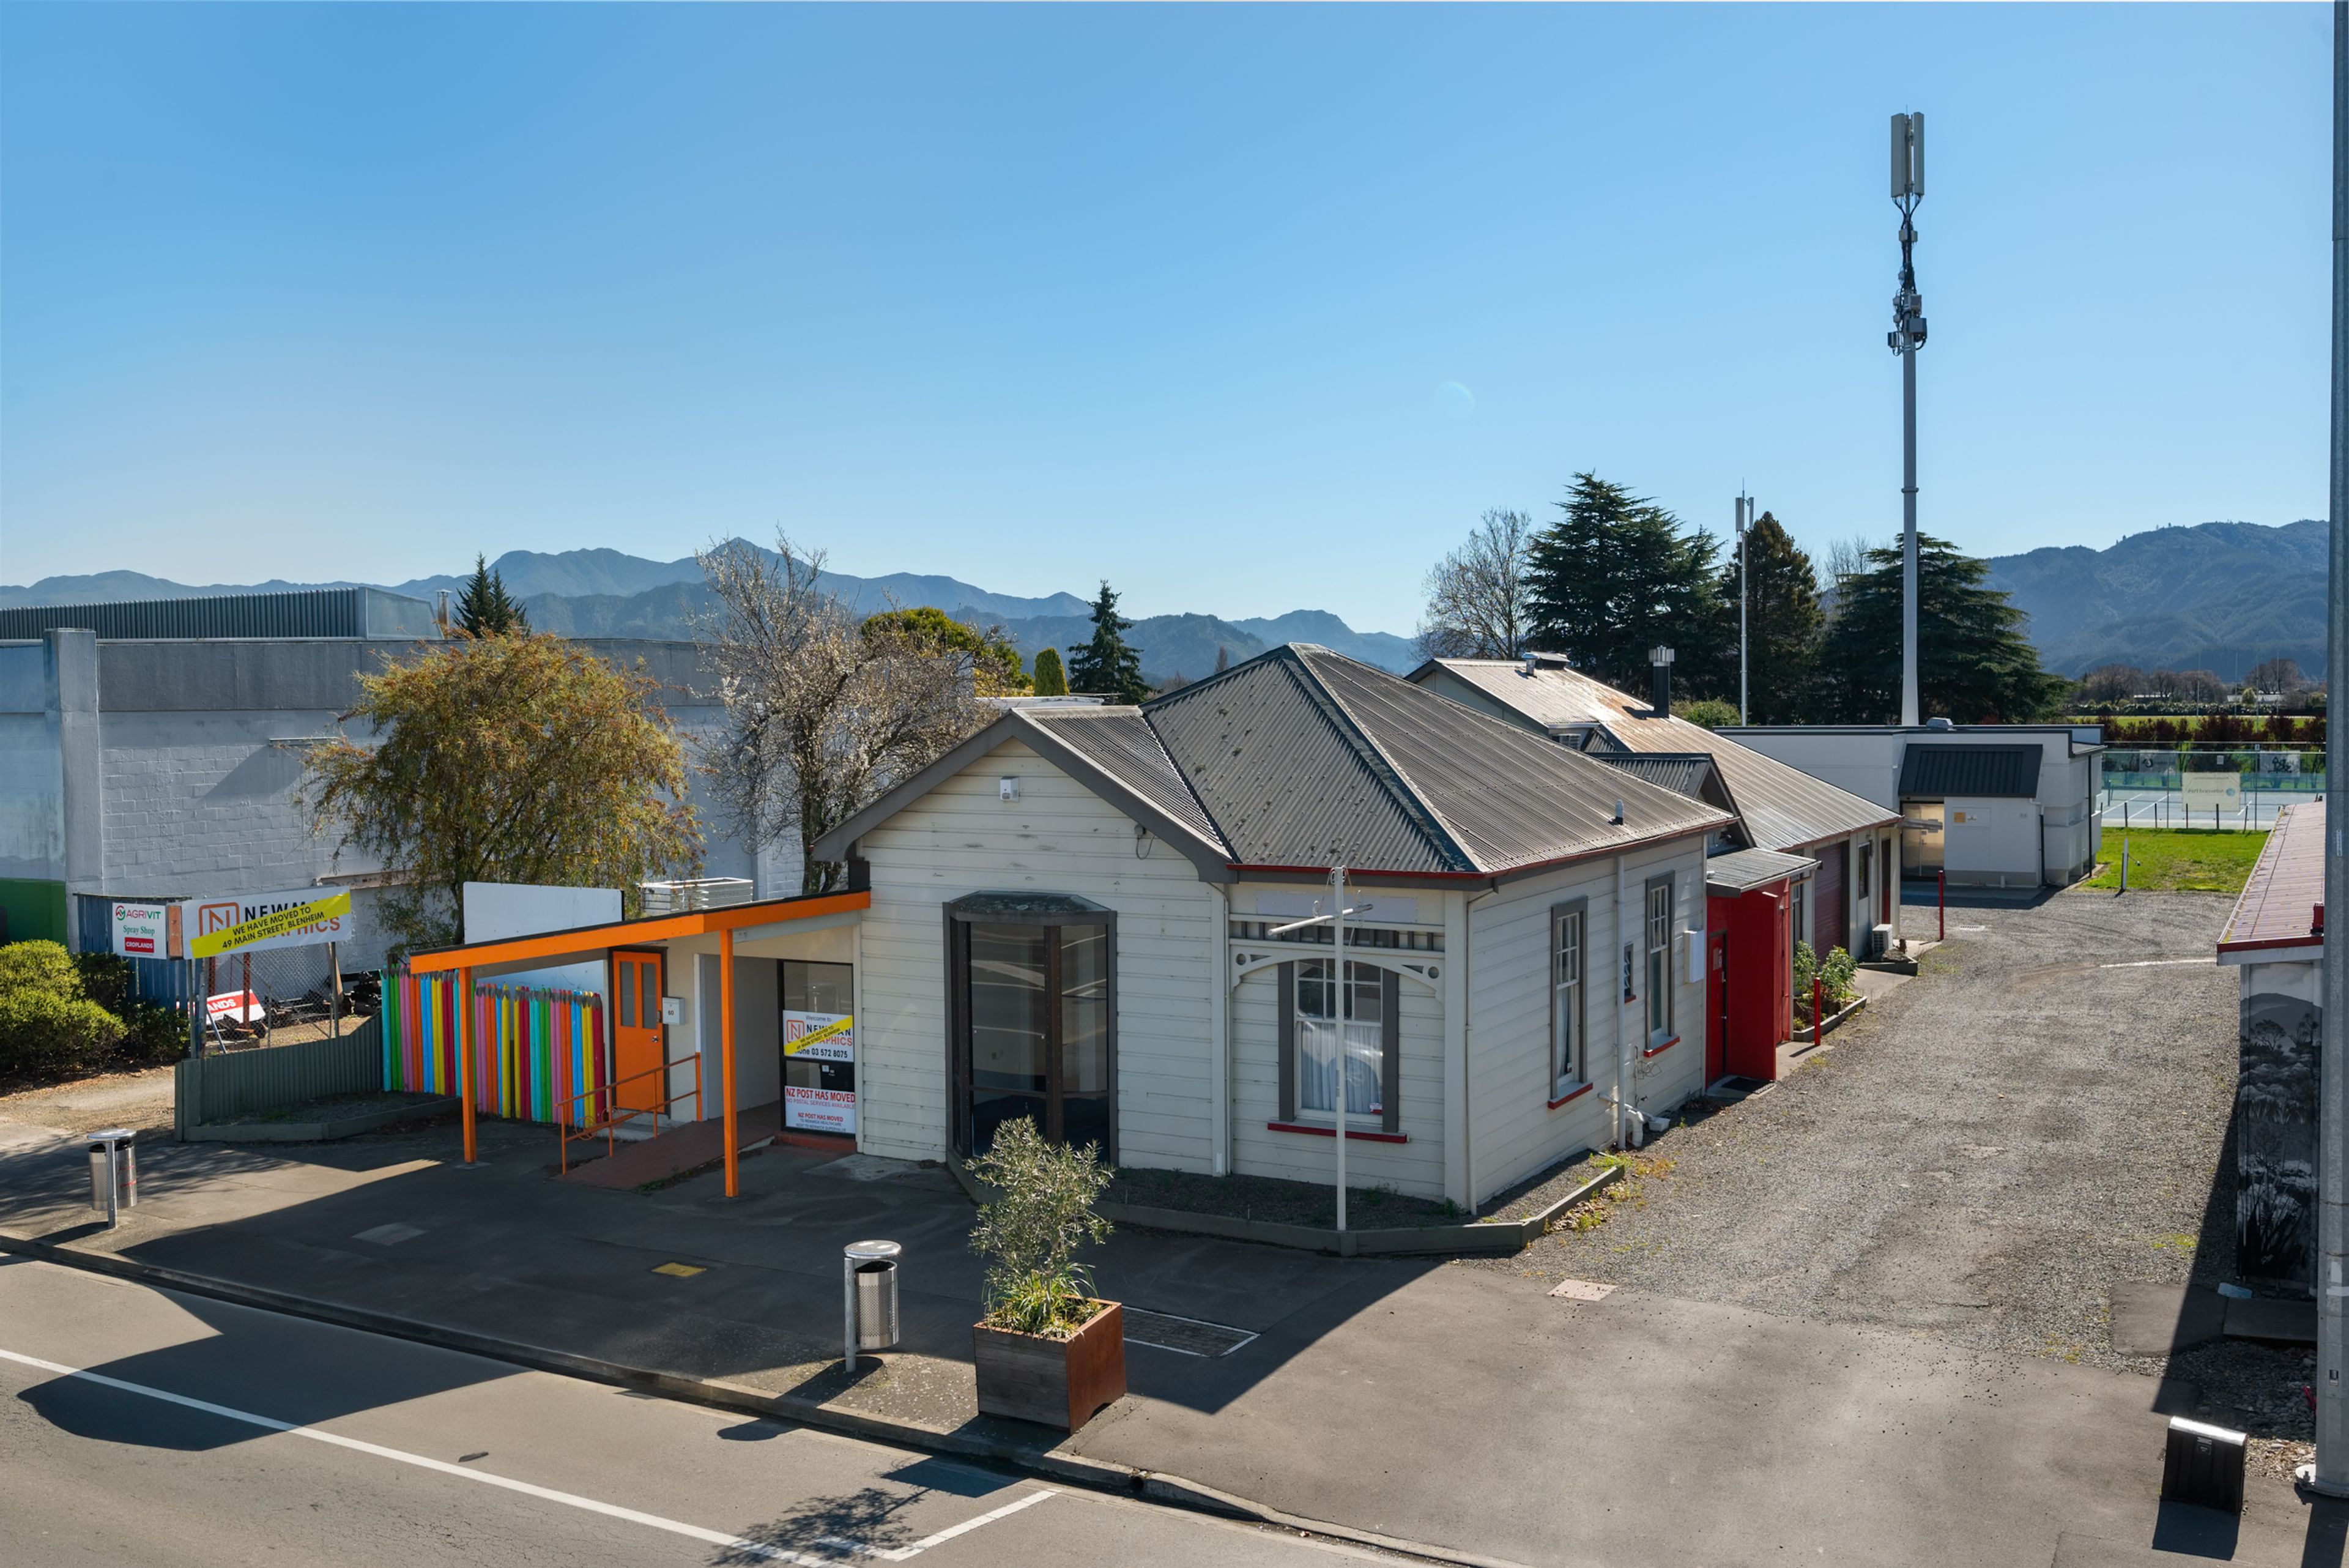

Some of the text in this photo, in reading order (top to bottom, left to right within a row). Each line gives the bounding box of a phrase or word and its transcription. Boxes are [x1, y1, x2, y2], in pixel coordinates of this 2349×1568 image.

[126, 909, 161, 920] AGRIVIT
[232, 926, 245, 935] WE
[247, 919, 268, 931] HAVE
[270, 910, 299, 924] MOVED
[123, 925, 155, 936] Spray Shop
[222, 912, 324, 948] 49 MAIN STREET, BLENHEIM
[786, 1088, 855, 1102] NZ POST HAS MOVED
